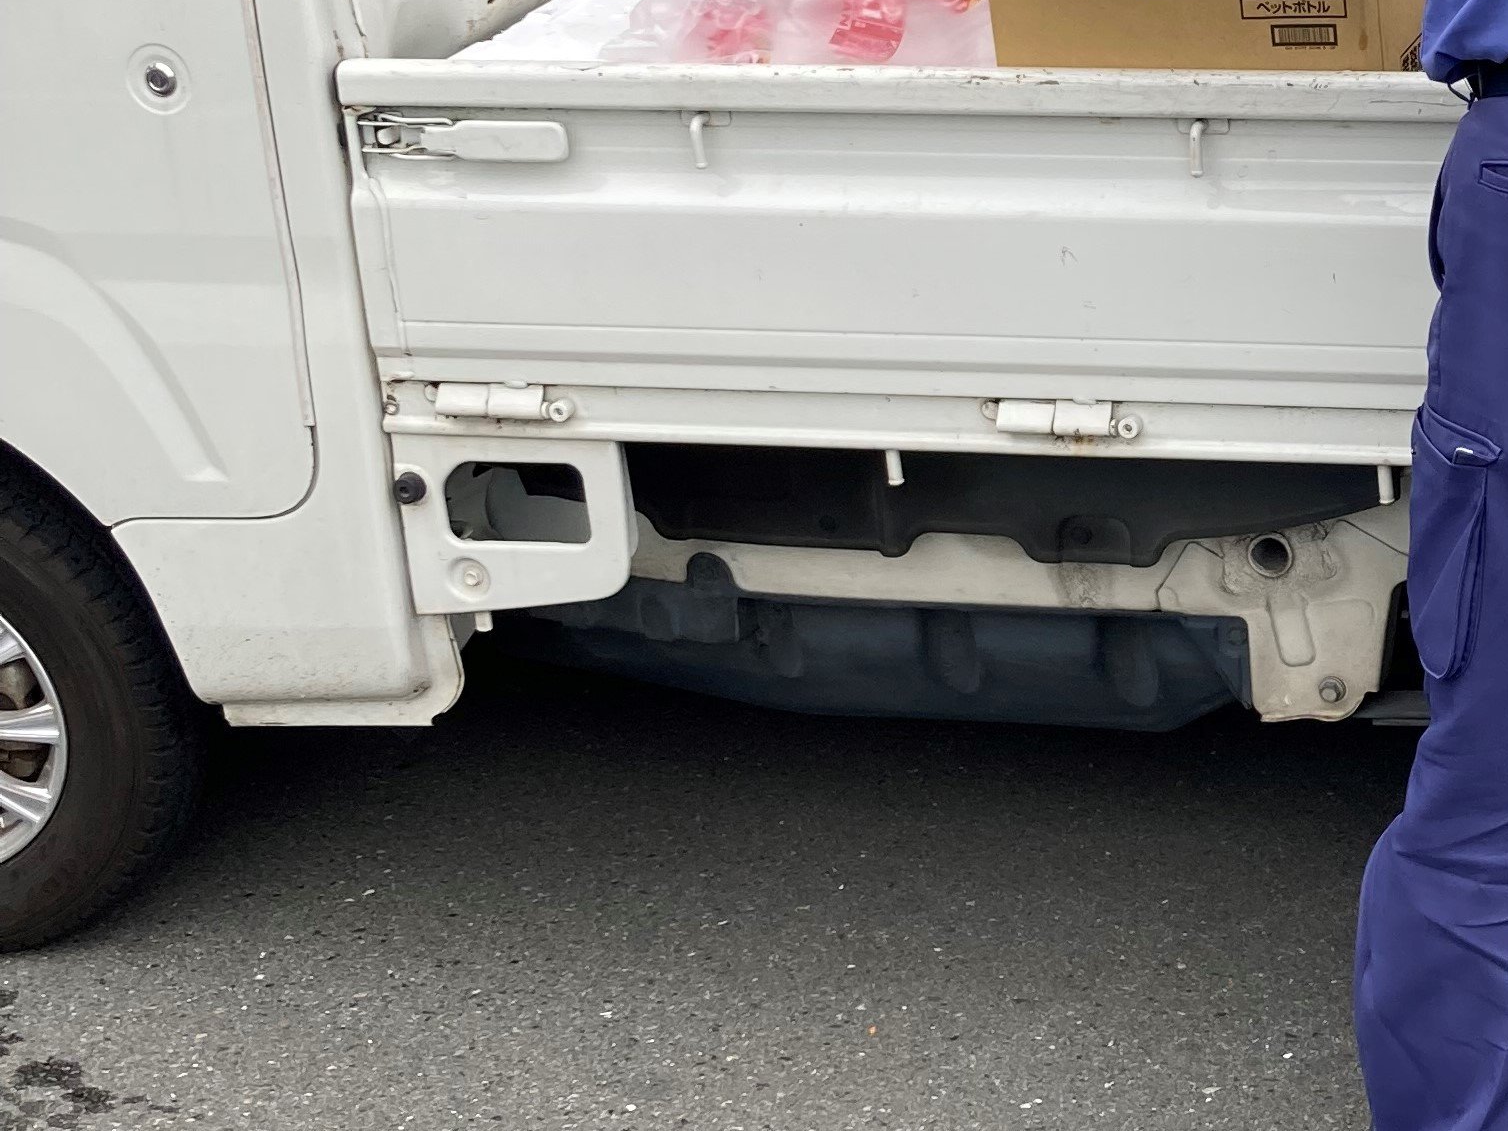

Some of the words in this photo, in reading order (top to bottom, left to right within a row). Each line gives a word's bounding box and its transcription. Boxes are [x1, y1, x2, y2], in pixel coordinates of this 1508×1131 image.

[1256, 0, 1331, 15] ペットボトル
